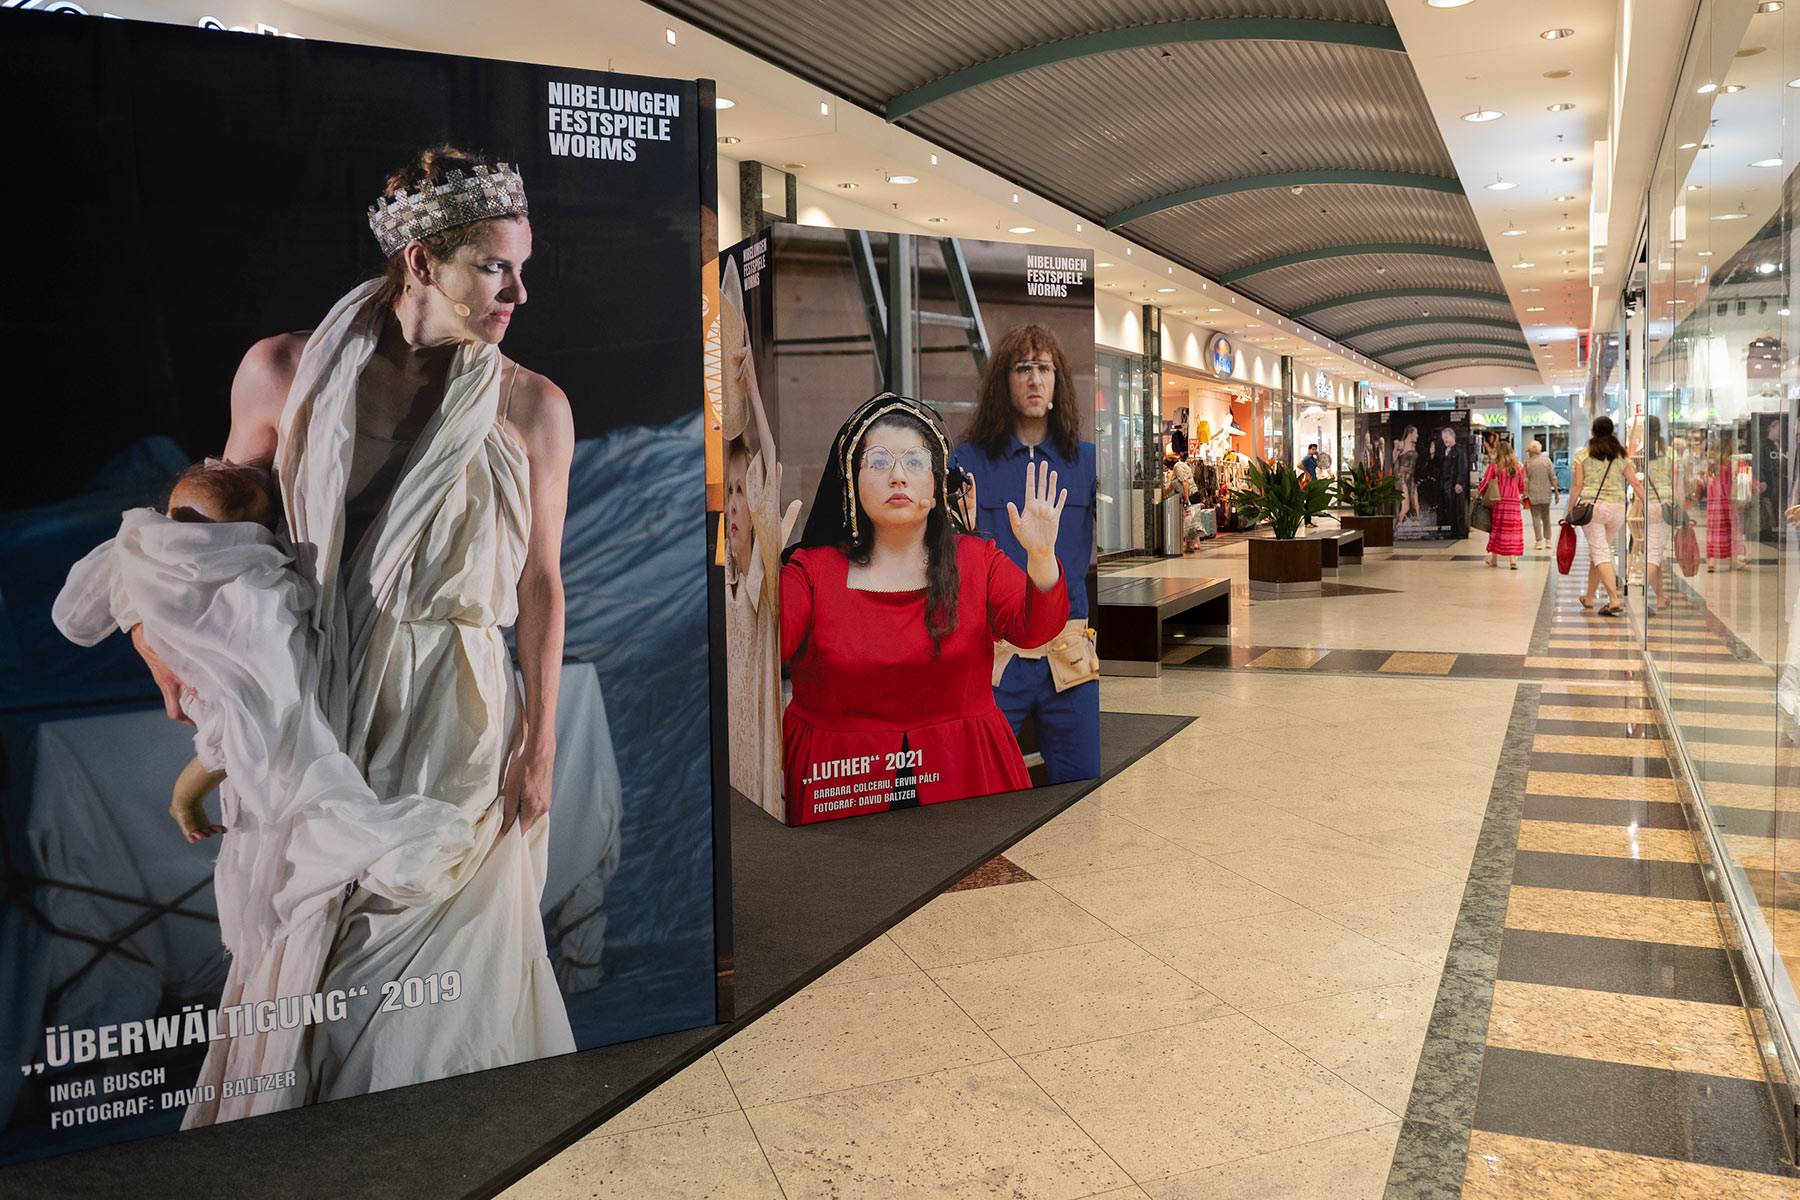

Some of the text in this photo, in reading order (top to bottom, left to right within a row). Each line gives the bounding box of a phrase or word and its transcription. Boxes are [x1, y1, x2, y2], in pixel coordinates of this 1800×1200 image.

[548, 81, 680, 117] NIBELUNGEN
[548, 107, 671, 141] FESTSPIELE
[548, 132, 637, 162] WORMS
[1027, 255, 1087, 271] NIBELUNGEN
[1027, 269, 1083, 285] FESTSPIELE
[1027, 282, 1068, 298] WORMS
[885, 749, 923, 770] 2021
[814, 784, 851, 800] BARBARA
[895, 775, 917, 788] ERVIN
[813, 789, 916, 814] FOTOGRAF: DAVID BALTZER
[380, 970, 462, 1014] 2019
[50, 1067, 166, 1103] INGA BUSCH
[50, 1070, 297, 1130] FOTOGRAF: DAVID BALTZER
